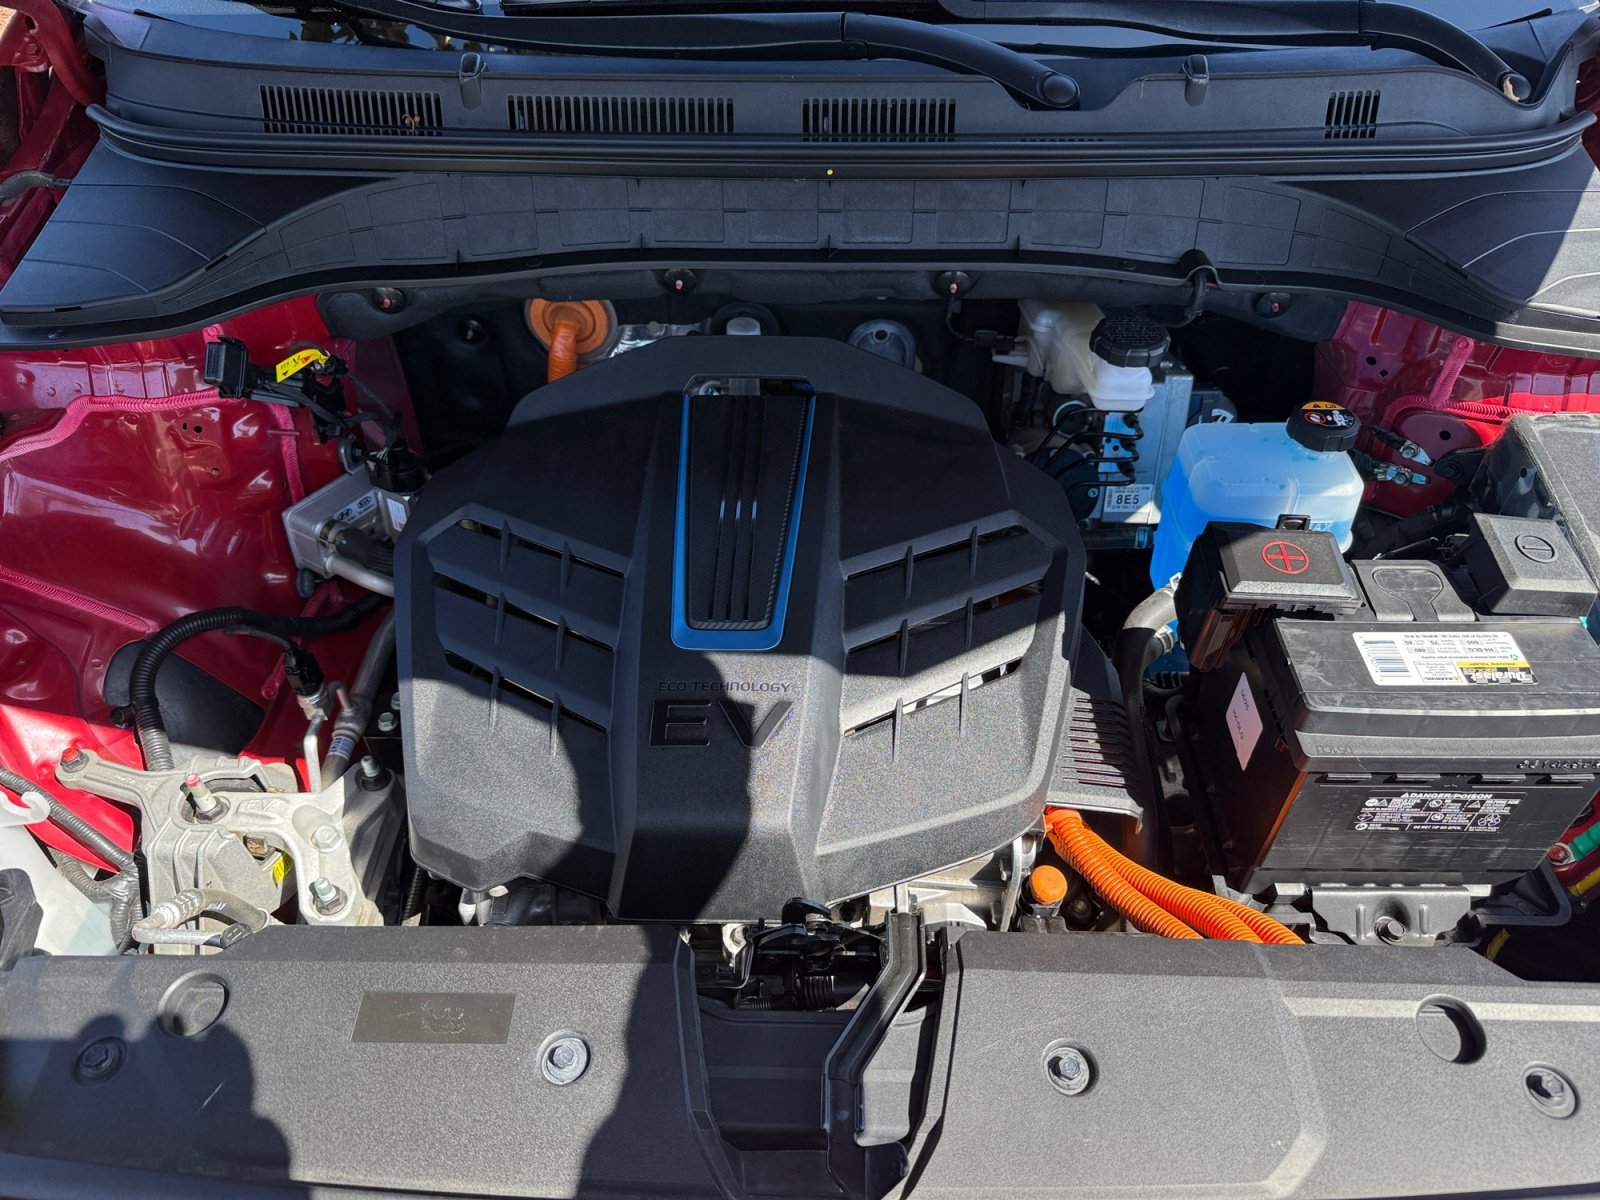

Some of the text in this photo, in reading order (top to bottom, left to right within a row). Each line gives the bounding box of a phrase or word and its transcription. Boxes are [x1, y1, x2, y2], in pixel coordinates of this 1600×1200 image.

[1116, 494, 1139, 505] 8E5
[1470, 671, 1532, 682] Duralast
[658, 681, 791, 693] ECO TECHNOLOGY
[649, 699, 795, 749] EV
[1409, 792, 1493, 800] DANGER/POISON
